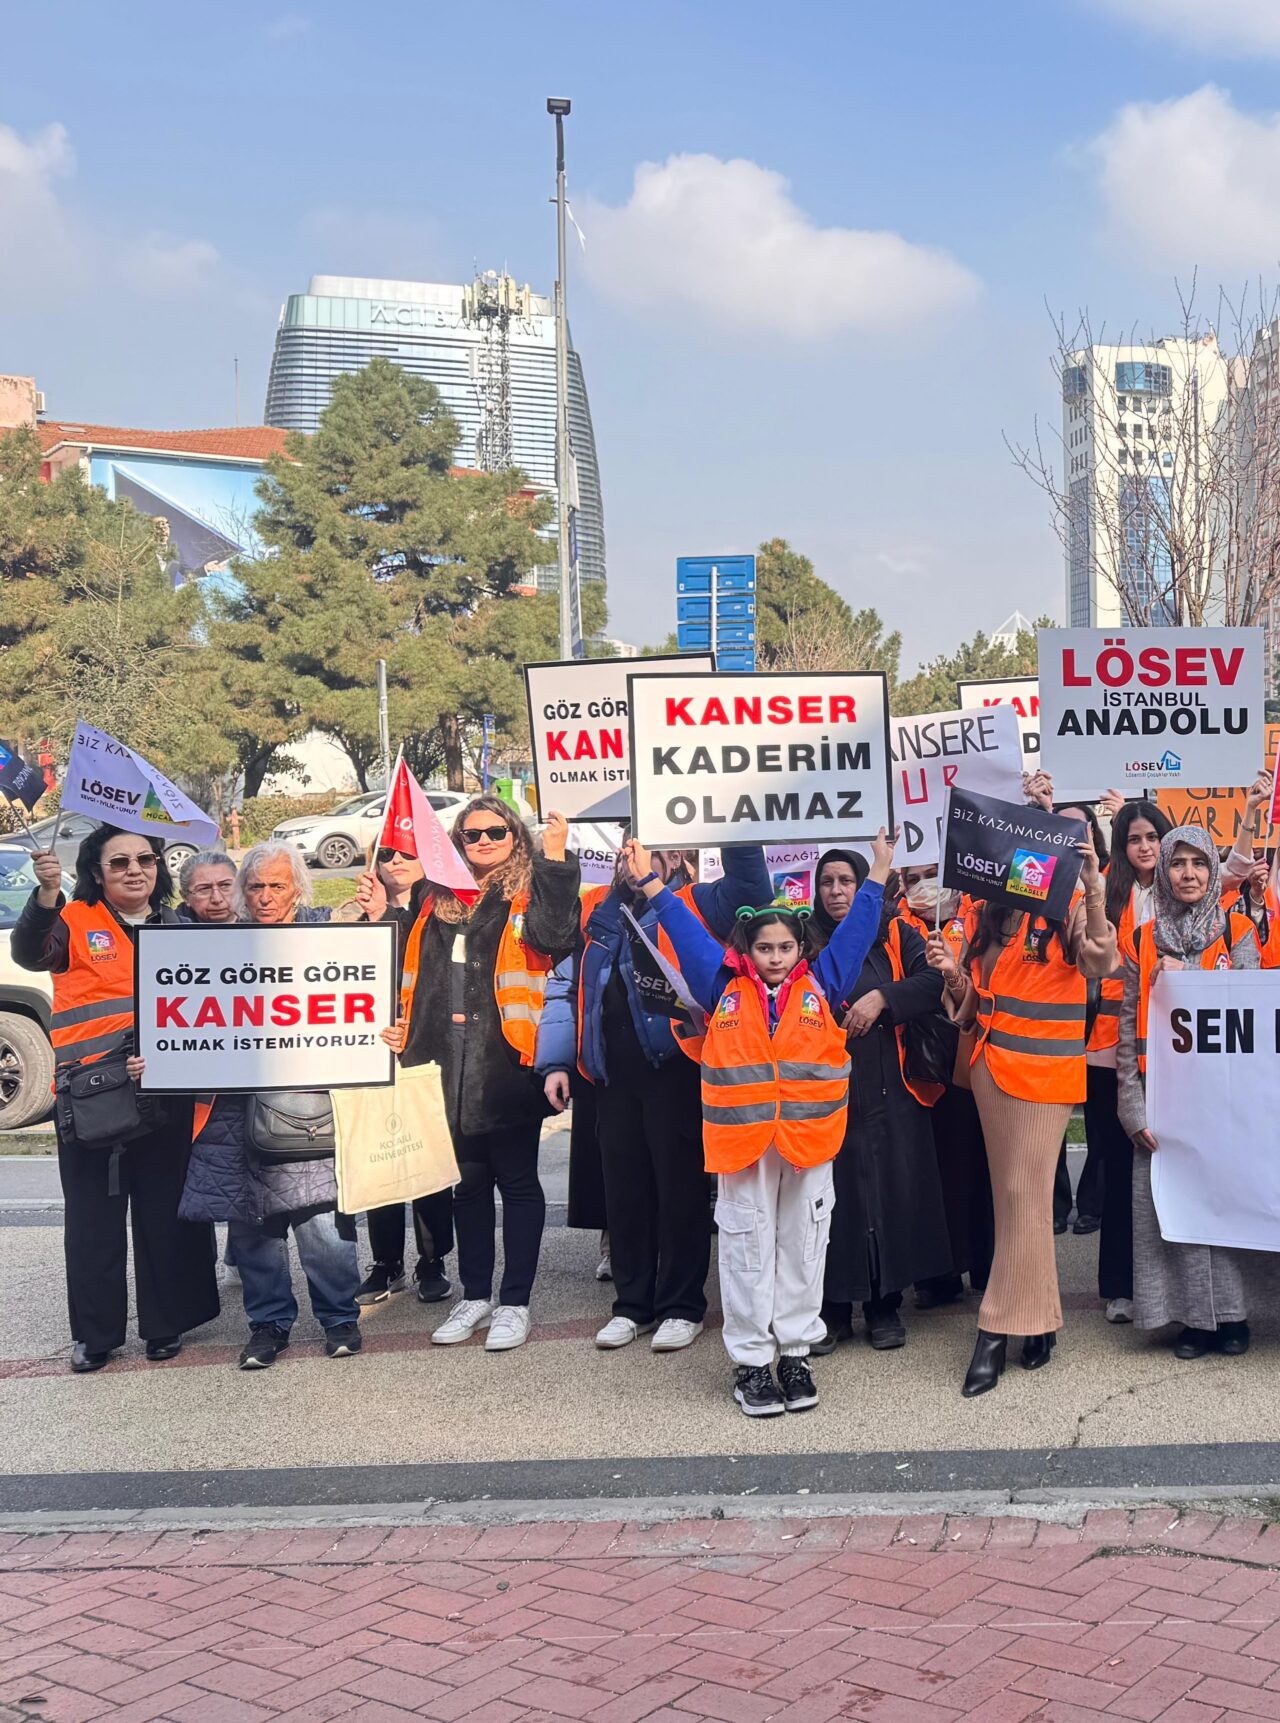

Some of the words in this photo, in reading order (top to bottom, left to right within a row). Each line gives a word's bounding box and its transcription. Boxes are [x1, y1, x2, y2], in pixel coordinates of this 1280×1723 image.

[1062, 638, 1245, 687] LÖSEV
[543, 699, 582, 720] GÖZ
[587, 697, 628, 718] GÖR
[665, 695, 857, 726] KANSER
[1103, 689, 1206, 707] İSTANBUL
[1057, 707, 1248, 736] ANADOLU
[78, 734, 99, 749] BİZ
[545, 728, 624, 761] KAN
[891, 715, 999, 761] NSERE
[652, 735, 871, 775] KADERİM
[1125, 761, 1164, 771] LÖSEV
[550, 770, 598, 784] OLMAK
[902, 765, 958, 805] UR
[81, 778, 142, 806] LÖSEV
[146, 813, 170, 821] MÜCA
[665, 791, 863, 825] OLAMAZ
[953, 808, 974, 822] BİZ
[977, 814, 1078, 848] KAZANACAĞIZ
[1167, 806, 1223, 838] VAR
[708, 857, 720, 866] Bİ
[766, 851, 820, 864] NACAĞIZ
[956, 852, 1006, 877] LÖSEV
[91, 953, 118, 962] LÖSEV
[155, 963, 211, 985] GÖZ
[220, 963, 294, 985] GÖRE
[303, 961, 376, 983] GÖRE
[156, 993, 376, 1028] KANSER
[799, 1016, 824, 1028] LÖSEV
[716, 1020, 739, 1029] LÖSEV
[1170, 1008, 1254, 1054] SEN
[156, 1038, 225, 1051] OLMAK
[233, 1034, 376, 1050] İSTEMİYORUZ!
